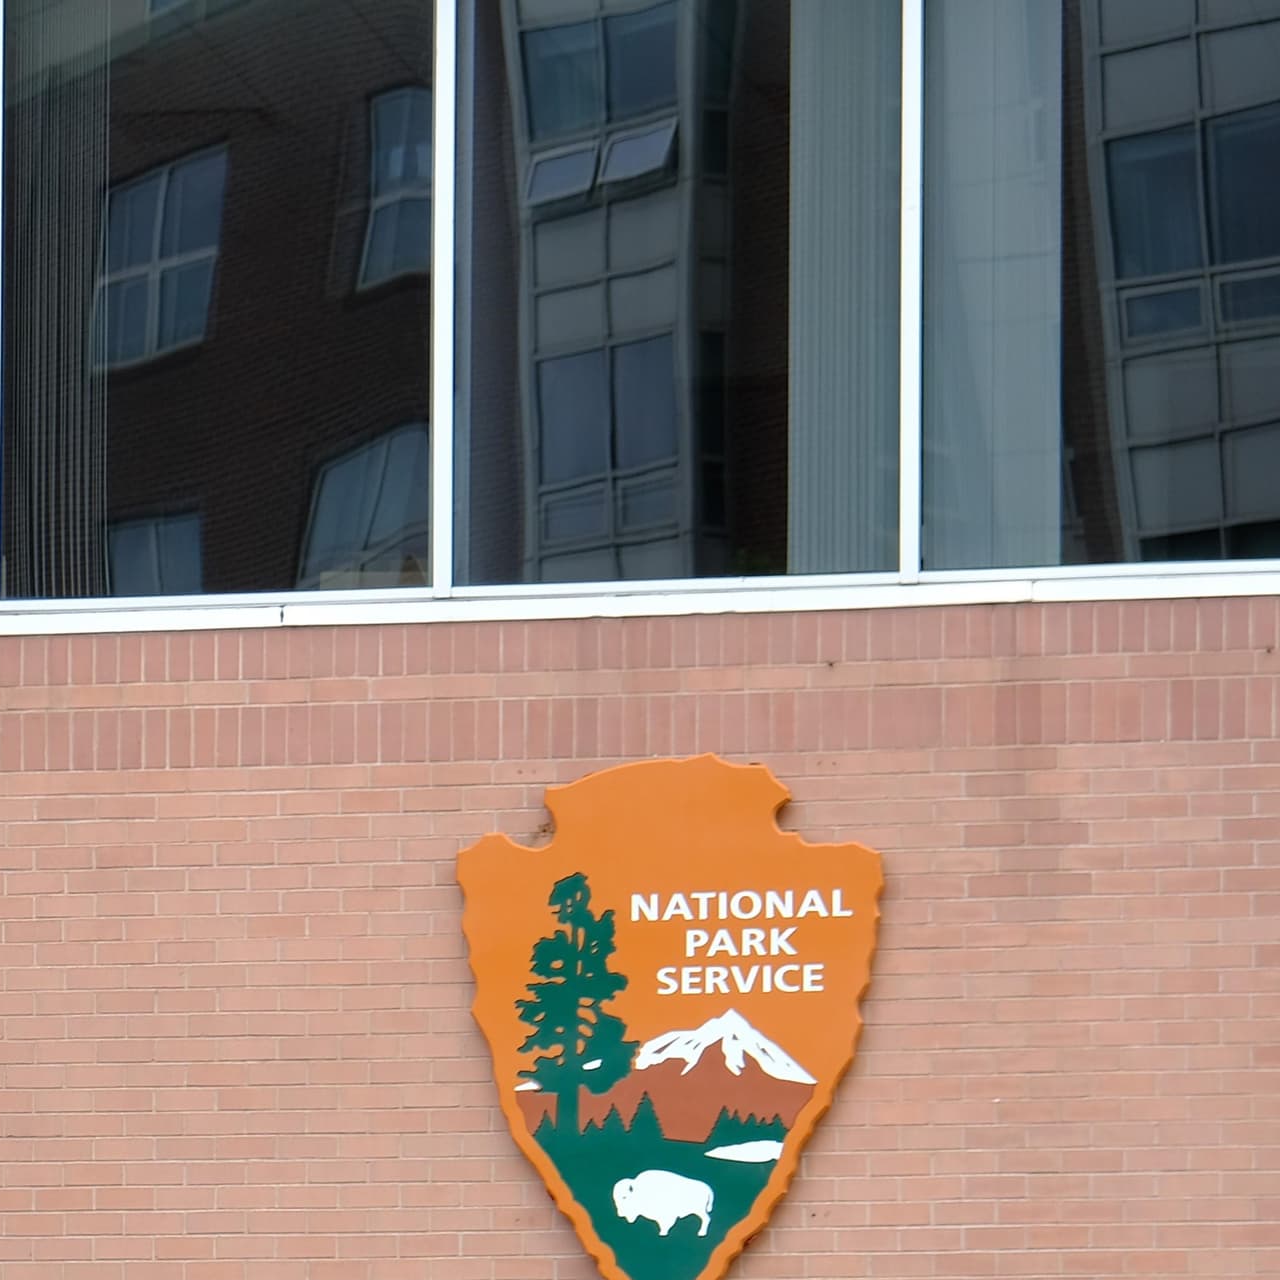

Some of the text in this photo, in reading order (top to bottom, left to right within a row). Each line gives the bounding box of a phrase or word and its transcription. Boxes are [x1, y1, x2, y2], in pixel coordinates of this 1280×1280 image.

[630, 888, 854, 922] NATIONAL
[685, 926, 798, 958] PARK
[655, 963, 825, 995] SERVICE
